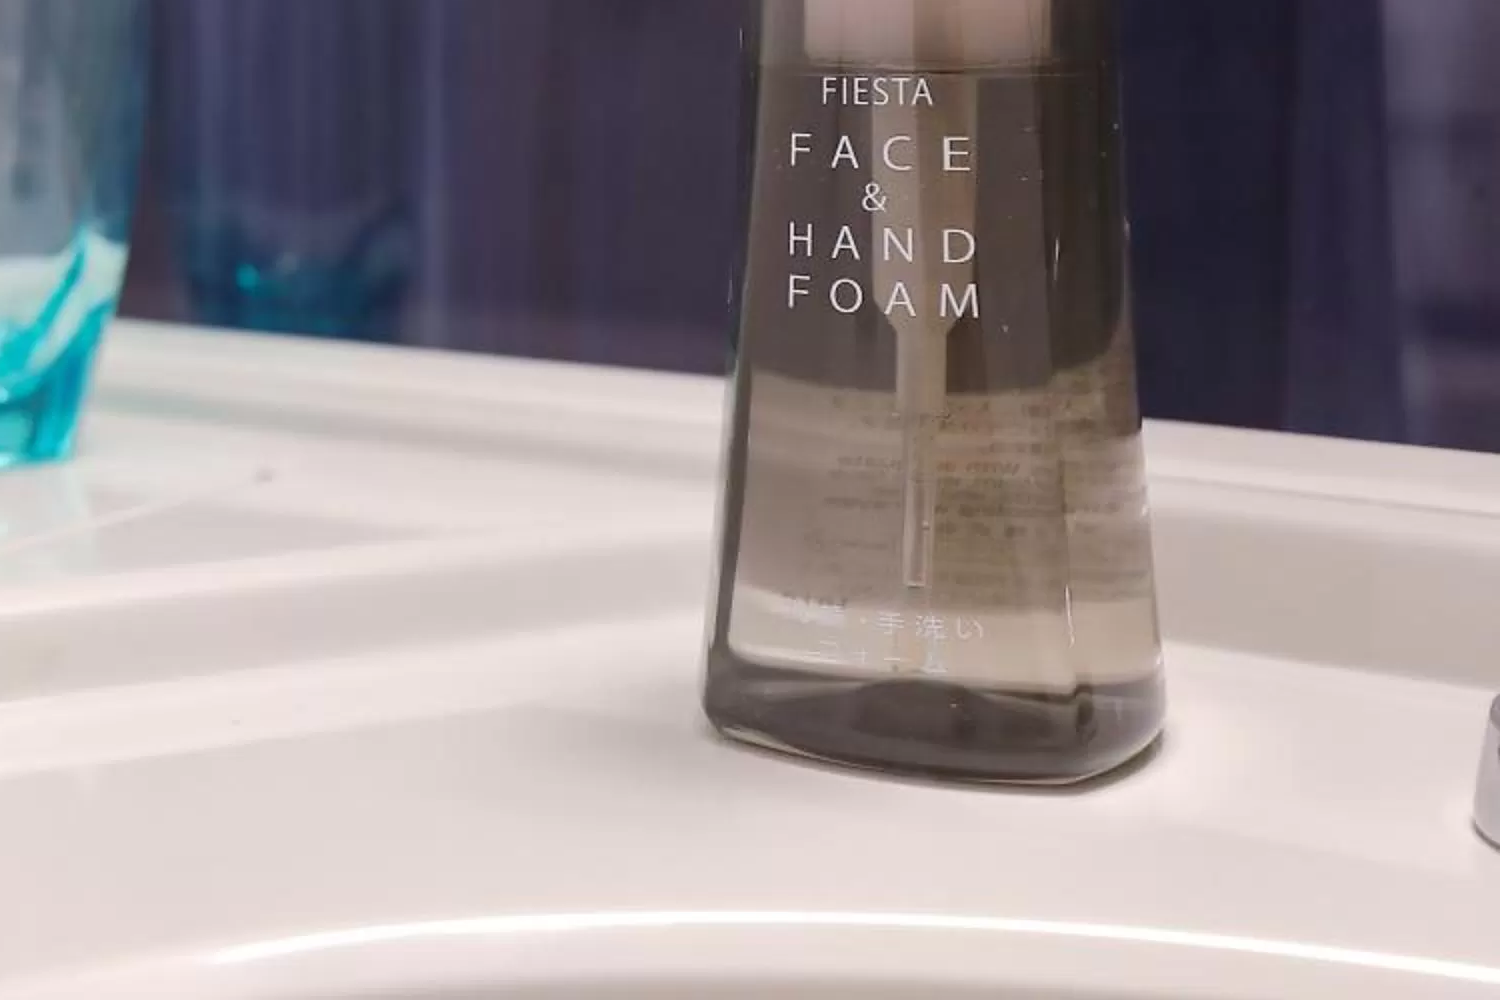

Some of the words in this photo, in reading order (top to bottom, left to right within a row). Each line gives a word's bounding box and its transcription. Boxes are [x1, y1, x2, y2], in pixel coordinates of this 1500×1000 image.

[822, 76, 934, 106] FIESTA
[789, 132, 972, 172] FACE
[861, 182, 888, 212] &
[788, 220, 976, 264] HAND
[787, 274, 980, 319] FOAM
